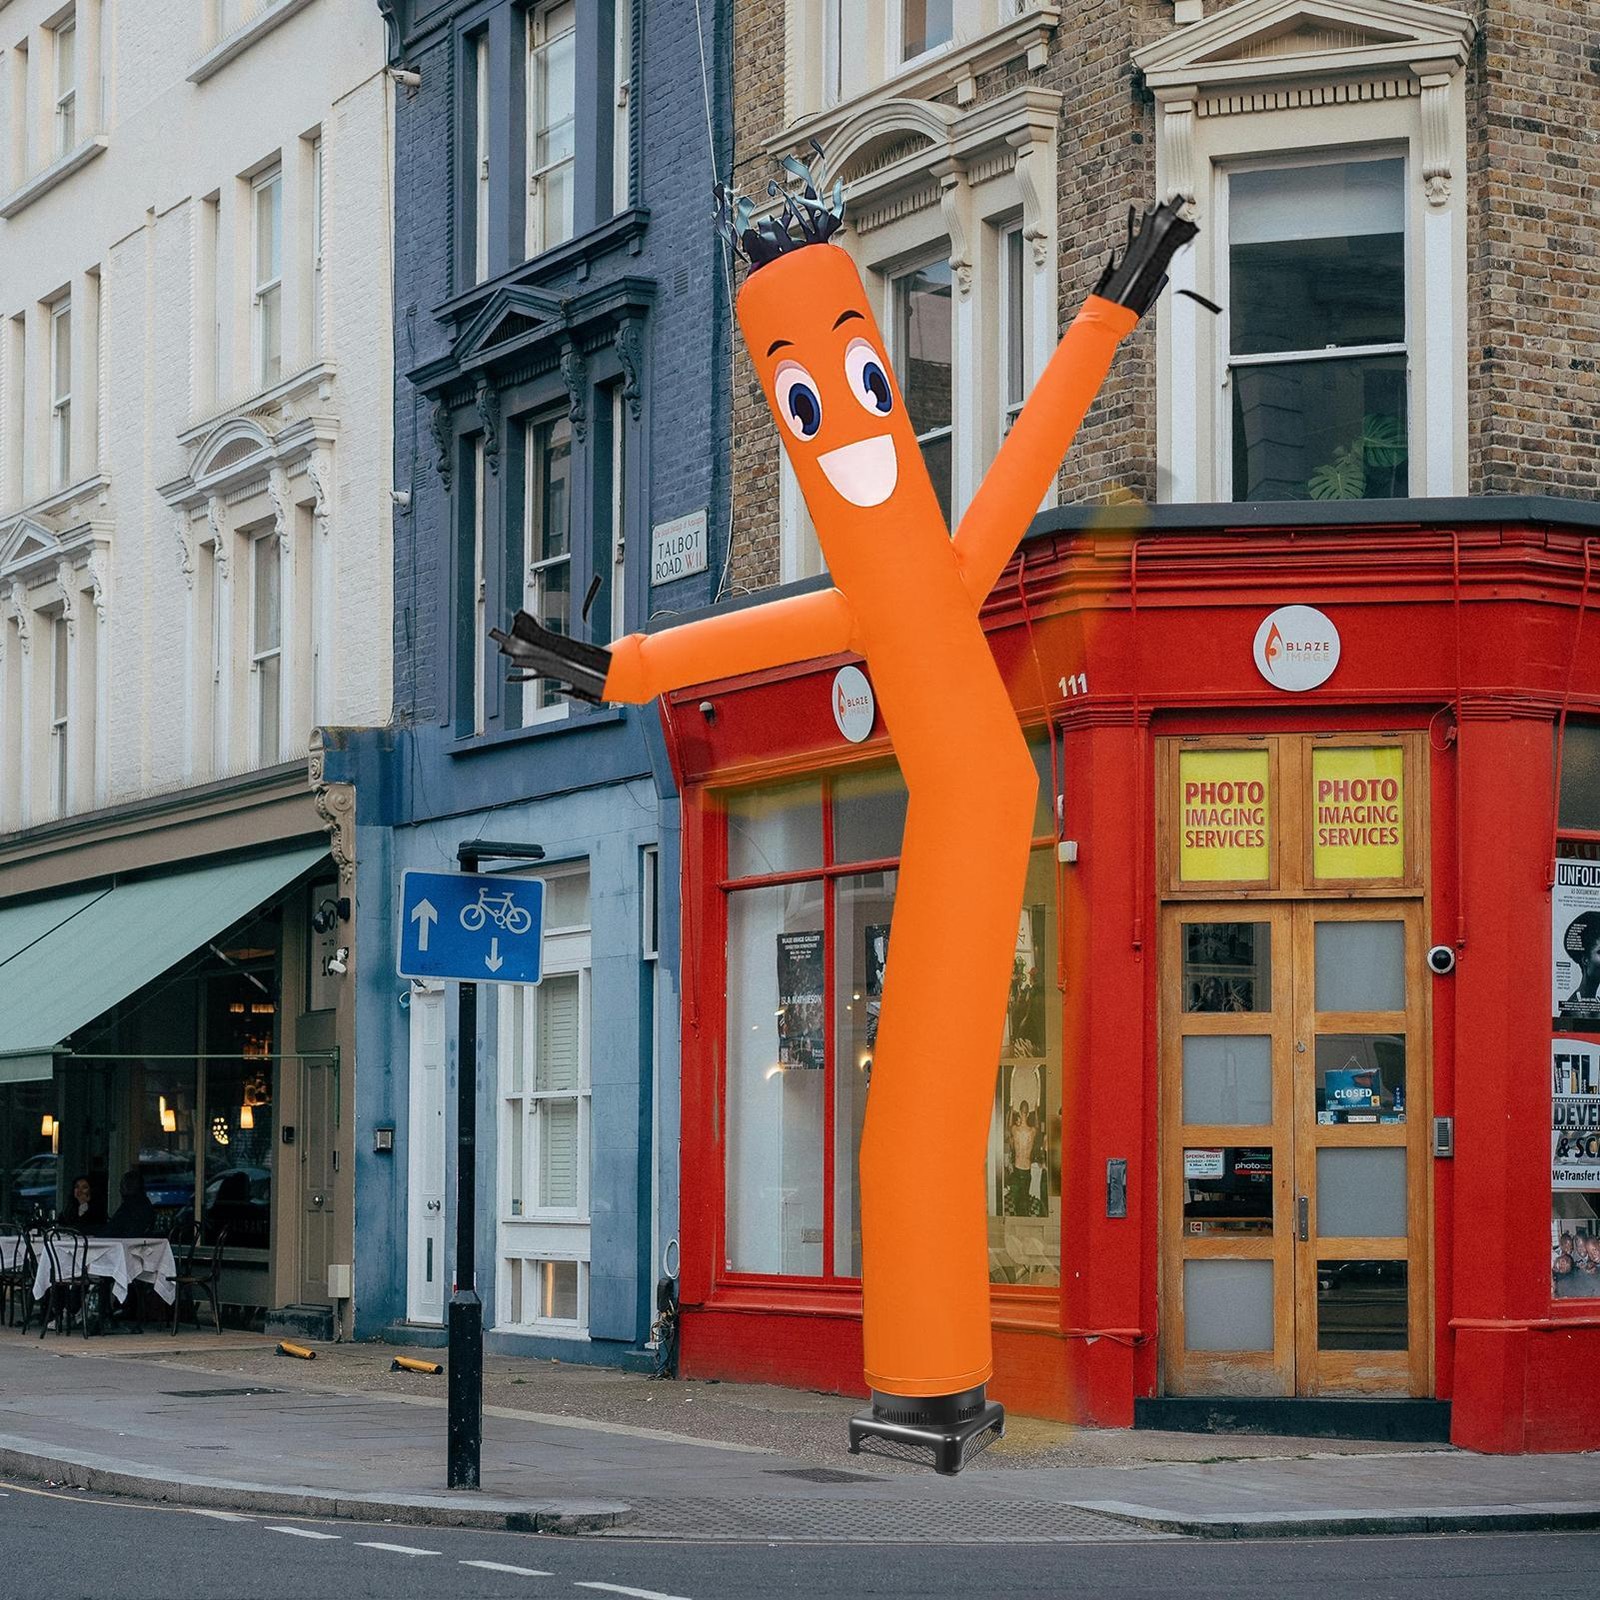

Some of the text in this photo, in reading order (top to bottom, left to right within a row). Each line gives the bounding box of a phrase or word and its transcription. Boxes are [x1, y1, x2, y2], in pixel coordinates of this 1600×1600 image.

[658, 530, 700, 560] TALBOT
[1286, 642, 1330, 651] BLAZE
[1286, 652, 1330, 662] IMAGE
[1058, 672, 1088, 698] 111
[847, 696, 868, 707] BLAZE
[1185, 780, 1265, 805] PHOTO
[1317, 778, 1399, 803] PHOTO
[1185, 807, 1265, 826] IMAGING
[1317, 804, 1399, 825] IMAGING
[1185, 829, 1265, 849] SERVICES
[1317, 826, 1399, 847] SERVICES
[1334, 1088, 1373, 1099] CLOSED
[1557, 1138, 1571, 1158] &
[1234, 1162, 1261, 1170] photo
[1552, 1170, 1595, 1181] WeTransfer
